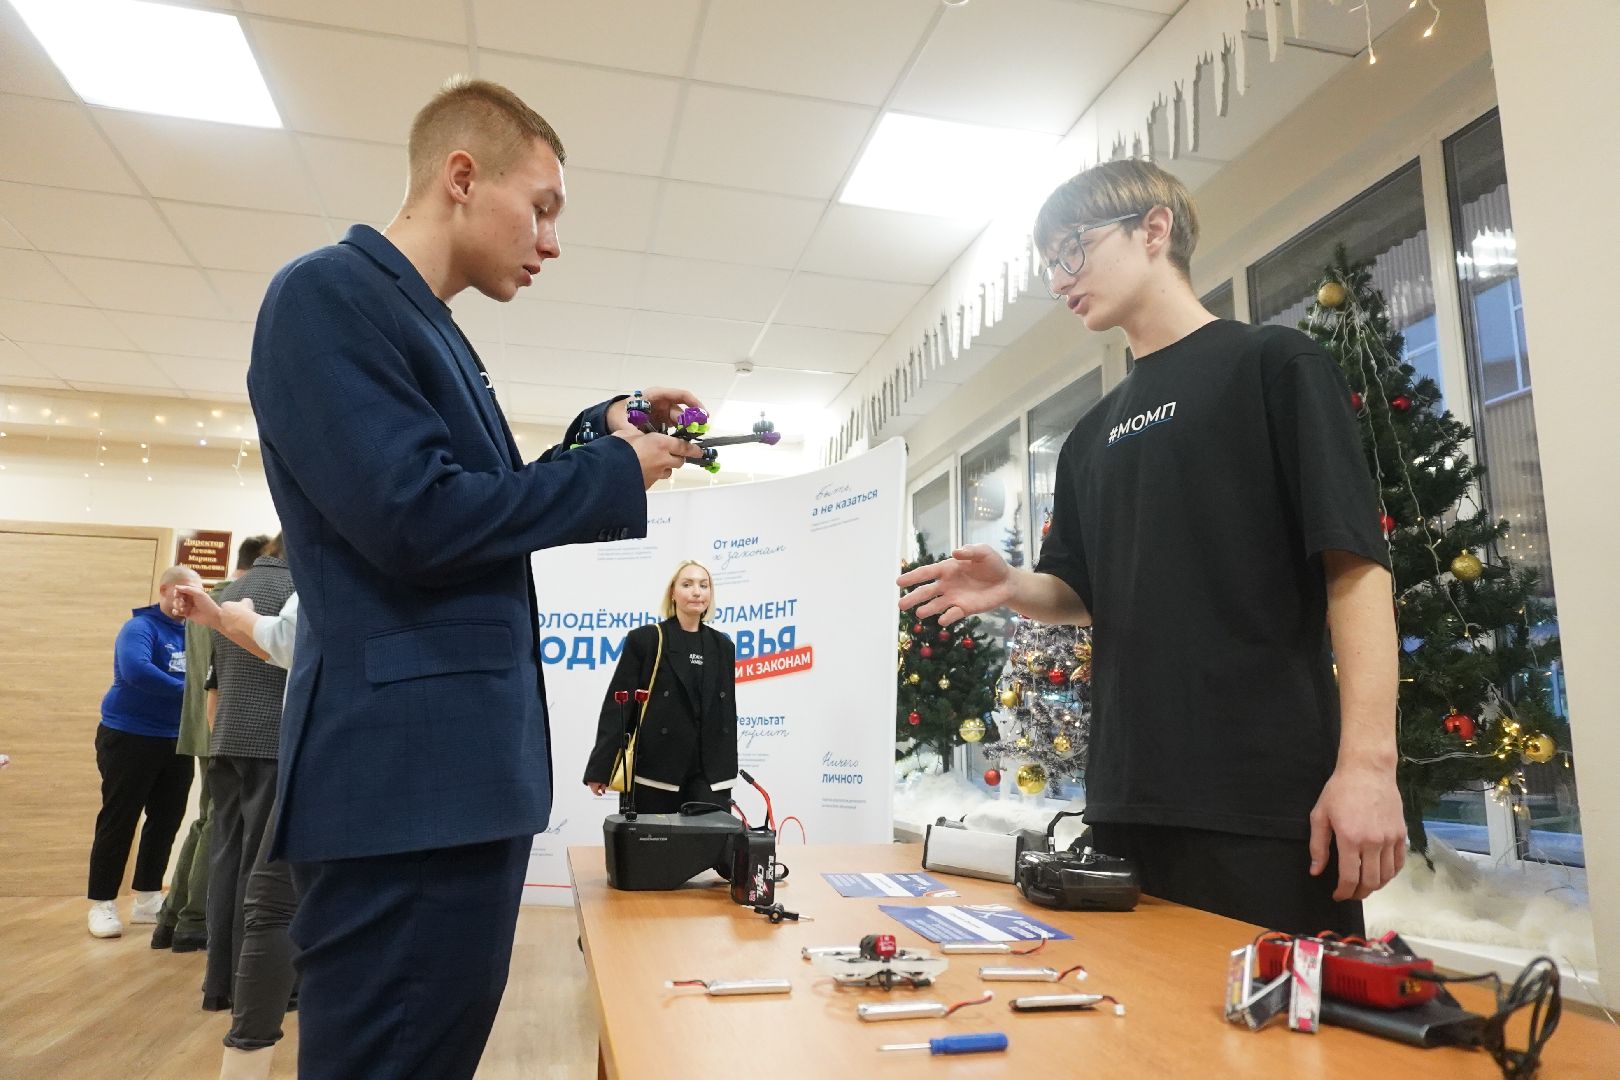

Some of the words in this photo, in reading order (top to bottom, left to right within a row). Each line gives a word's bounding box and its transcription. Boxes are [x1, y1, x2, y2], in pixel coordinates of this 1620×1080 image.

[1108, 401, 1177, 444] #МОМП
[812, 507, 818, 517] а
[820, 504, 834, 515] не
[835, 488, 878, 510] казаться
[713, 539, 728, 550] От
[730, 536, 759, 548] идеи
[746, 663, 754, 677] К
[755, 651, 811, 675] ЗАКОНАМ
[822, 773, 863, 785] личного
